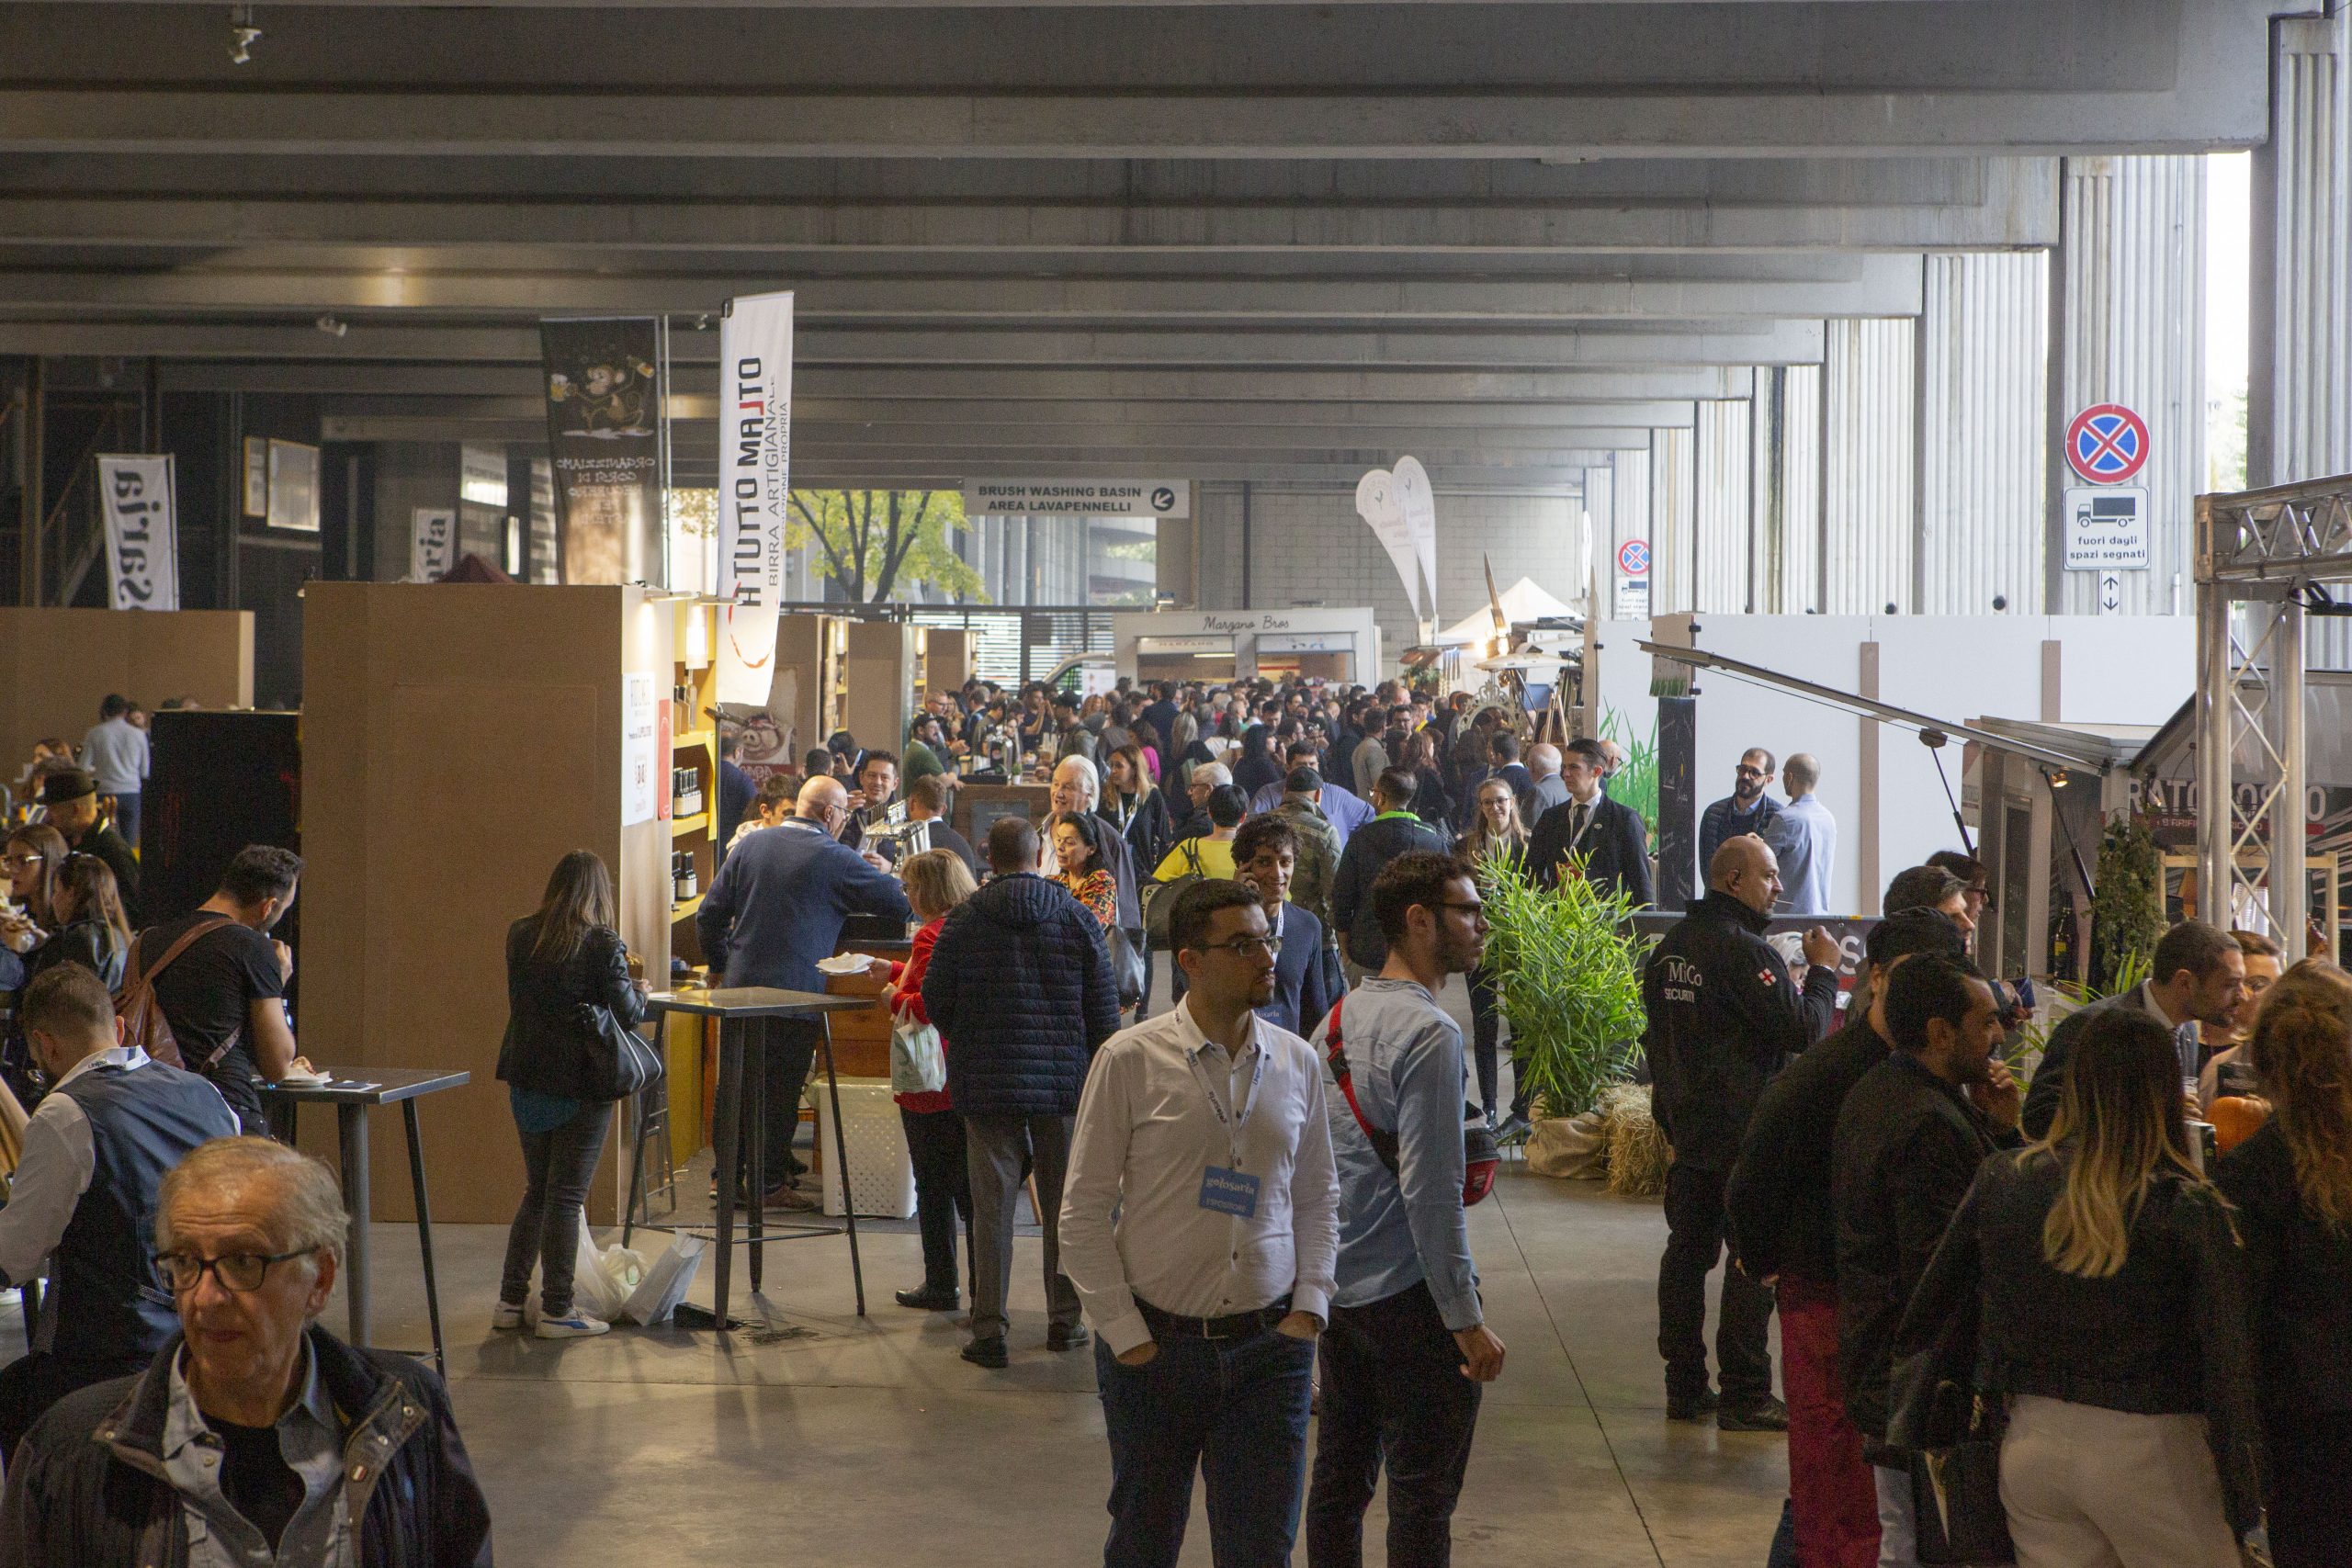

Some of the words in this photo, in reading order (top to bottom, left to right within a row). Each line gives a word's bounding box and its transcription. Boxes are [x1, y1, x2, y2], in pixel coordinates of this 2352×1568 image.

[737, 357, 764, 467] MALTO
[779, 402, 788, 463] PROPRIA
[978, 486, 1025, 497] BRUSH
[1029, 486, 1095, 497] WASHING
[1099, 487, 1141, 497] BASIN
[988, 501, 1024, 511] AREA
[1030, 501, 1131, 512] LAVAPENNELLI
[734, 478, 761, 580] TUTTO
[2078, 536, 2105, 545] fuori
[2109, 536, 2138, 547] dagli
[768, 525, 779, 587] BIRRA
[2070, 549, 2098, 560] spazi
[2103, 549, 2145, 560] segnati
[1202, 615, 1255, 634] Marzano
[1262, 615, 1289, 629] Bros
